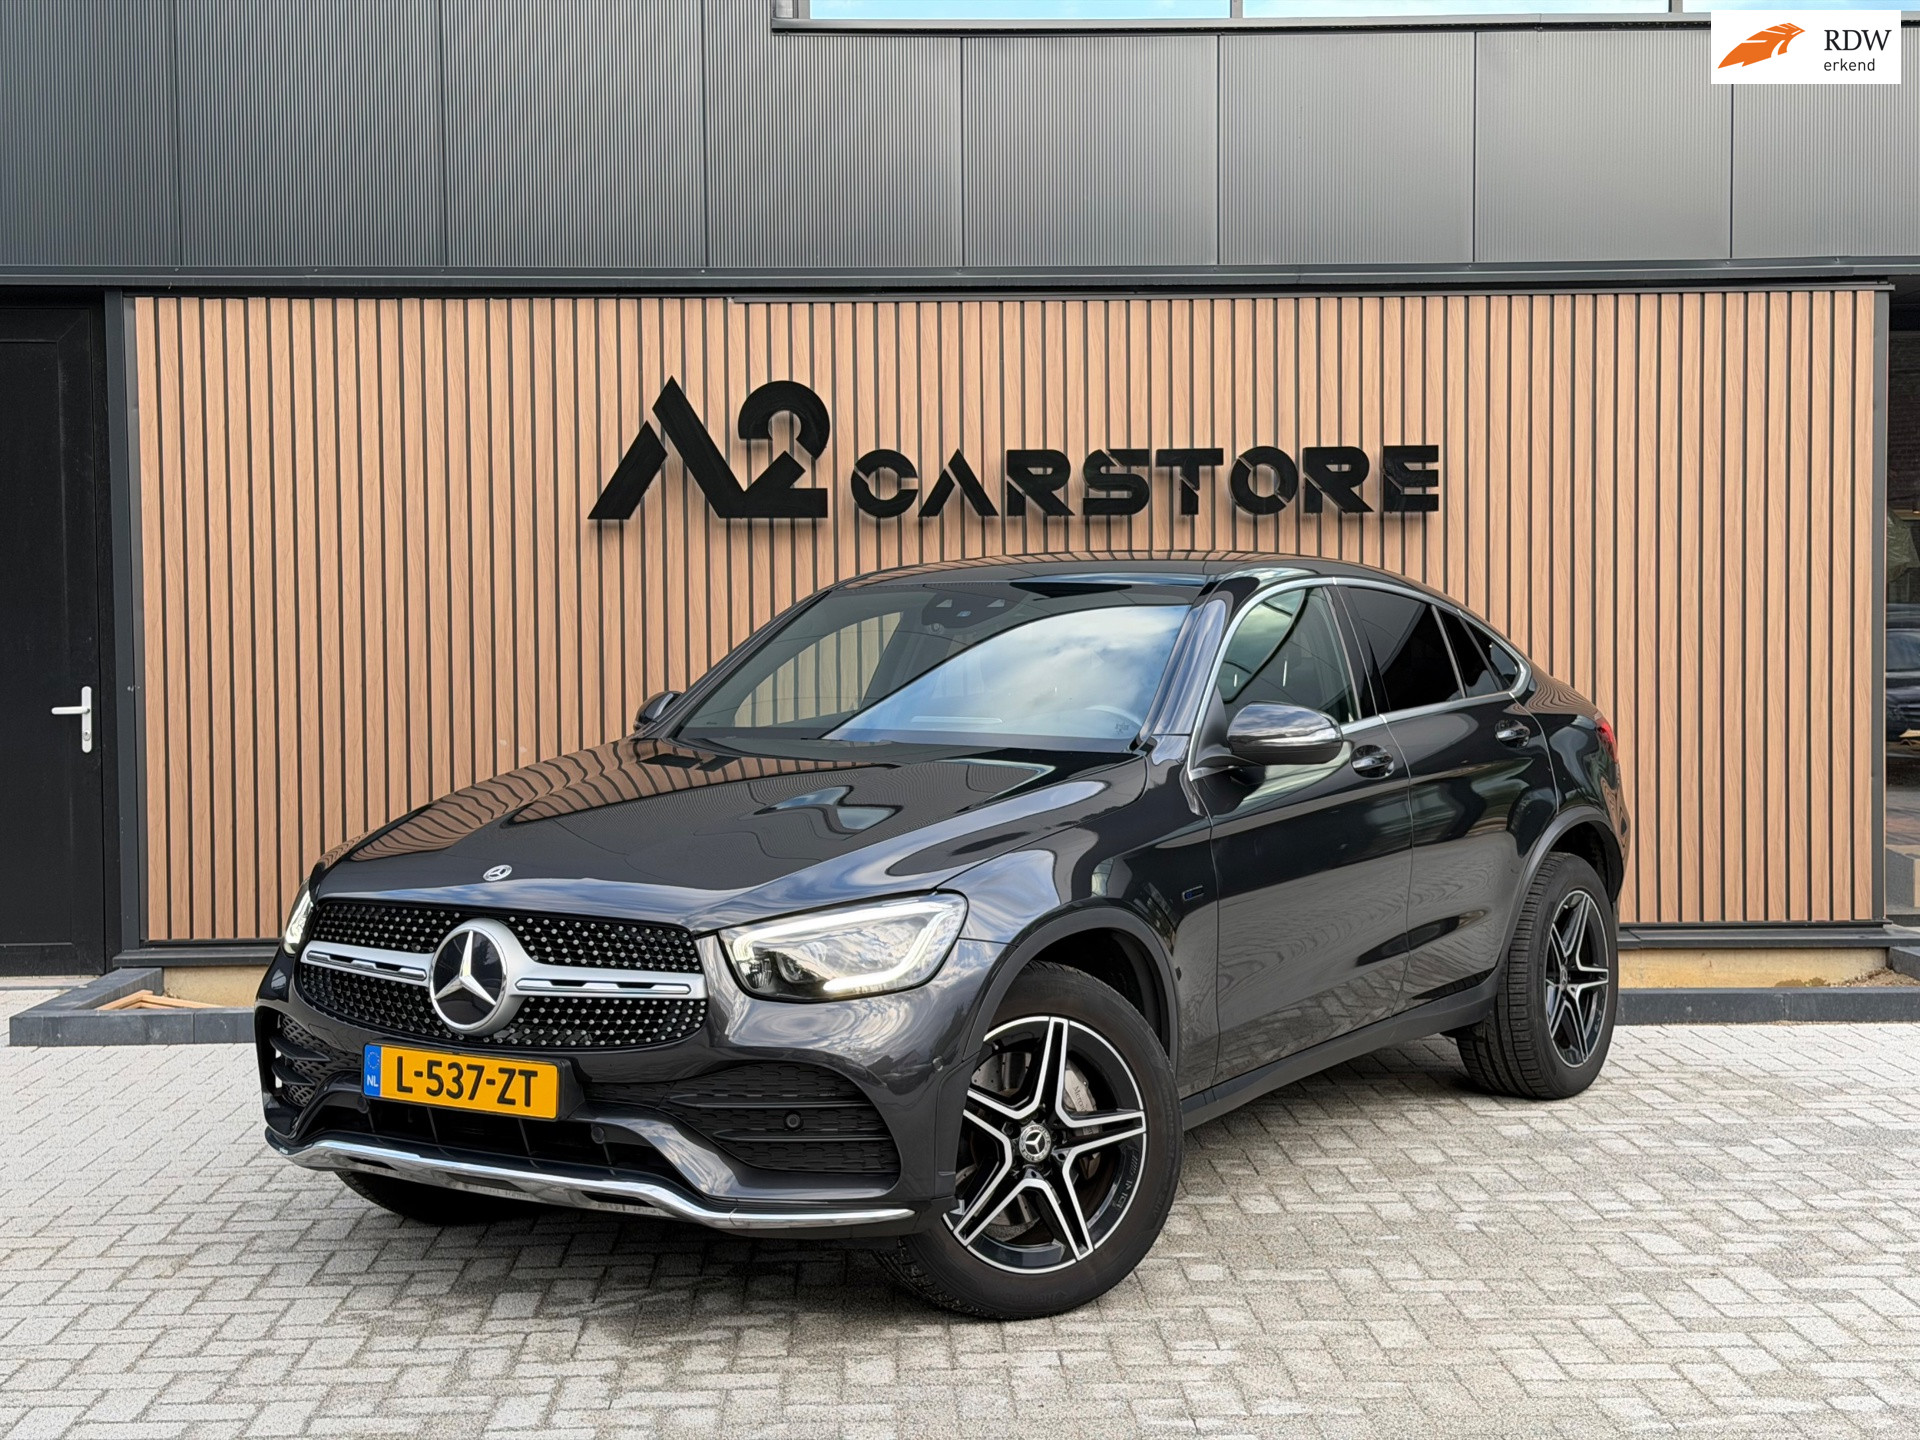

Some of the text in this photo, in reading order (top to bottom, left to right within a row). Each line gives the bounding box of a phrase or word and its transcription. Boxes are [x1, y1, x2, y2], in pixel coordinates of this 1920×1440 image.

[587, 375, 1440, 520] A2 CARSTORE
[366, 1075, 379, 1088] NL
[396, 1055, 538, 1108] L-537-ZT
